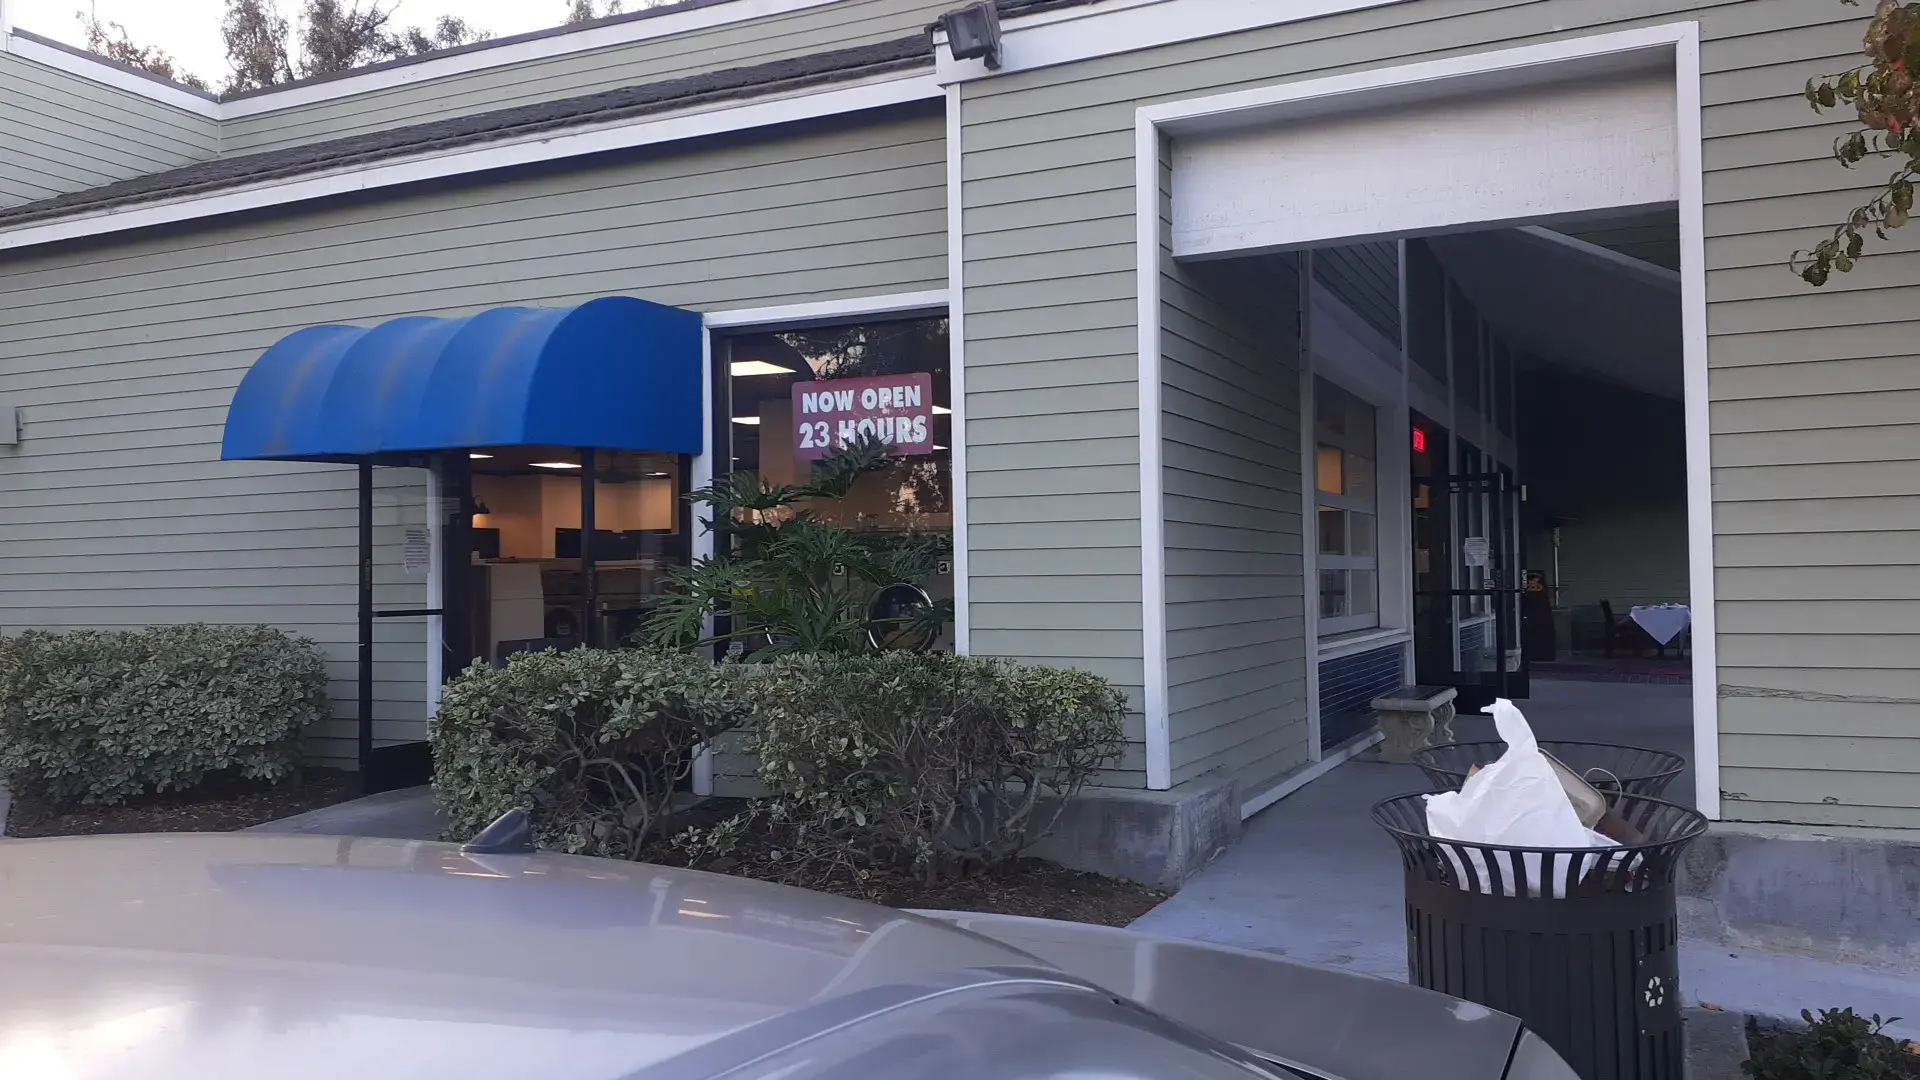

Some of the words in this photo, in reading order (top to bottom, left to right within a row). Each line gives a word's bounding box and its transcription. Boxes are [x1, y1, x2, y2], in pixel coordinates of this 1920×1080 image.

[802, 390, 855, 414] NOW
[861, 385, 921, 410] OPEN
[799, 421, 831, 449] 23
[838, 415, 928, 448] HOURS
